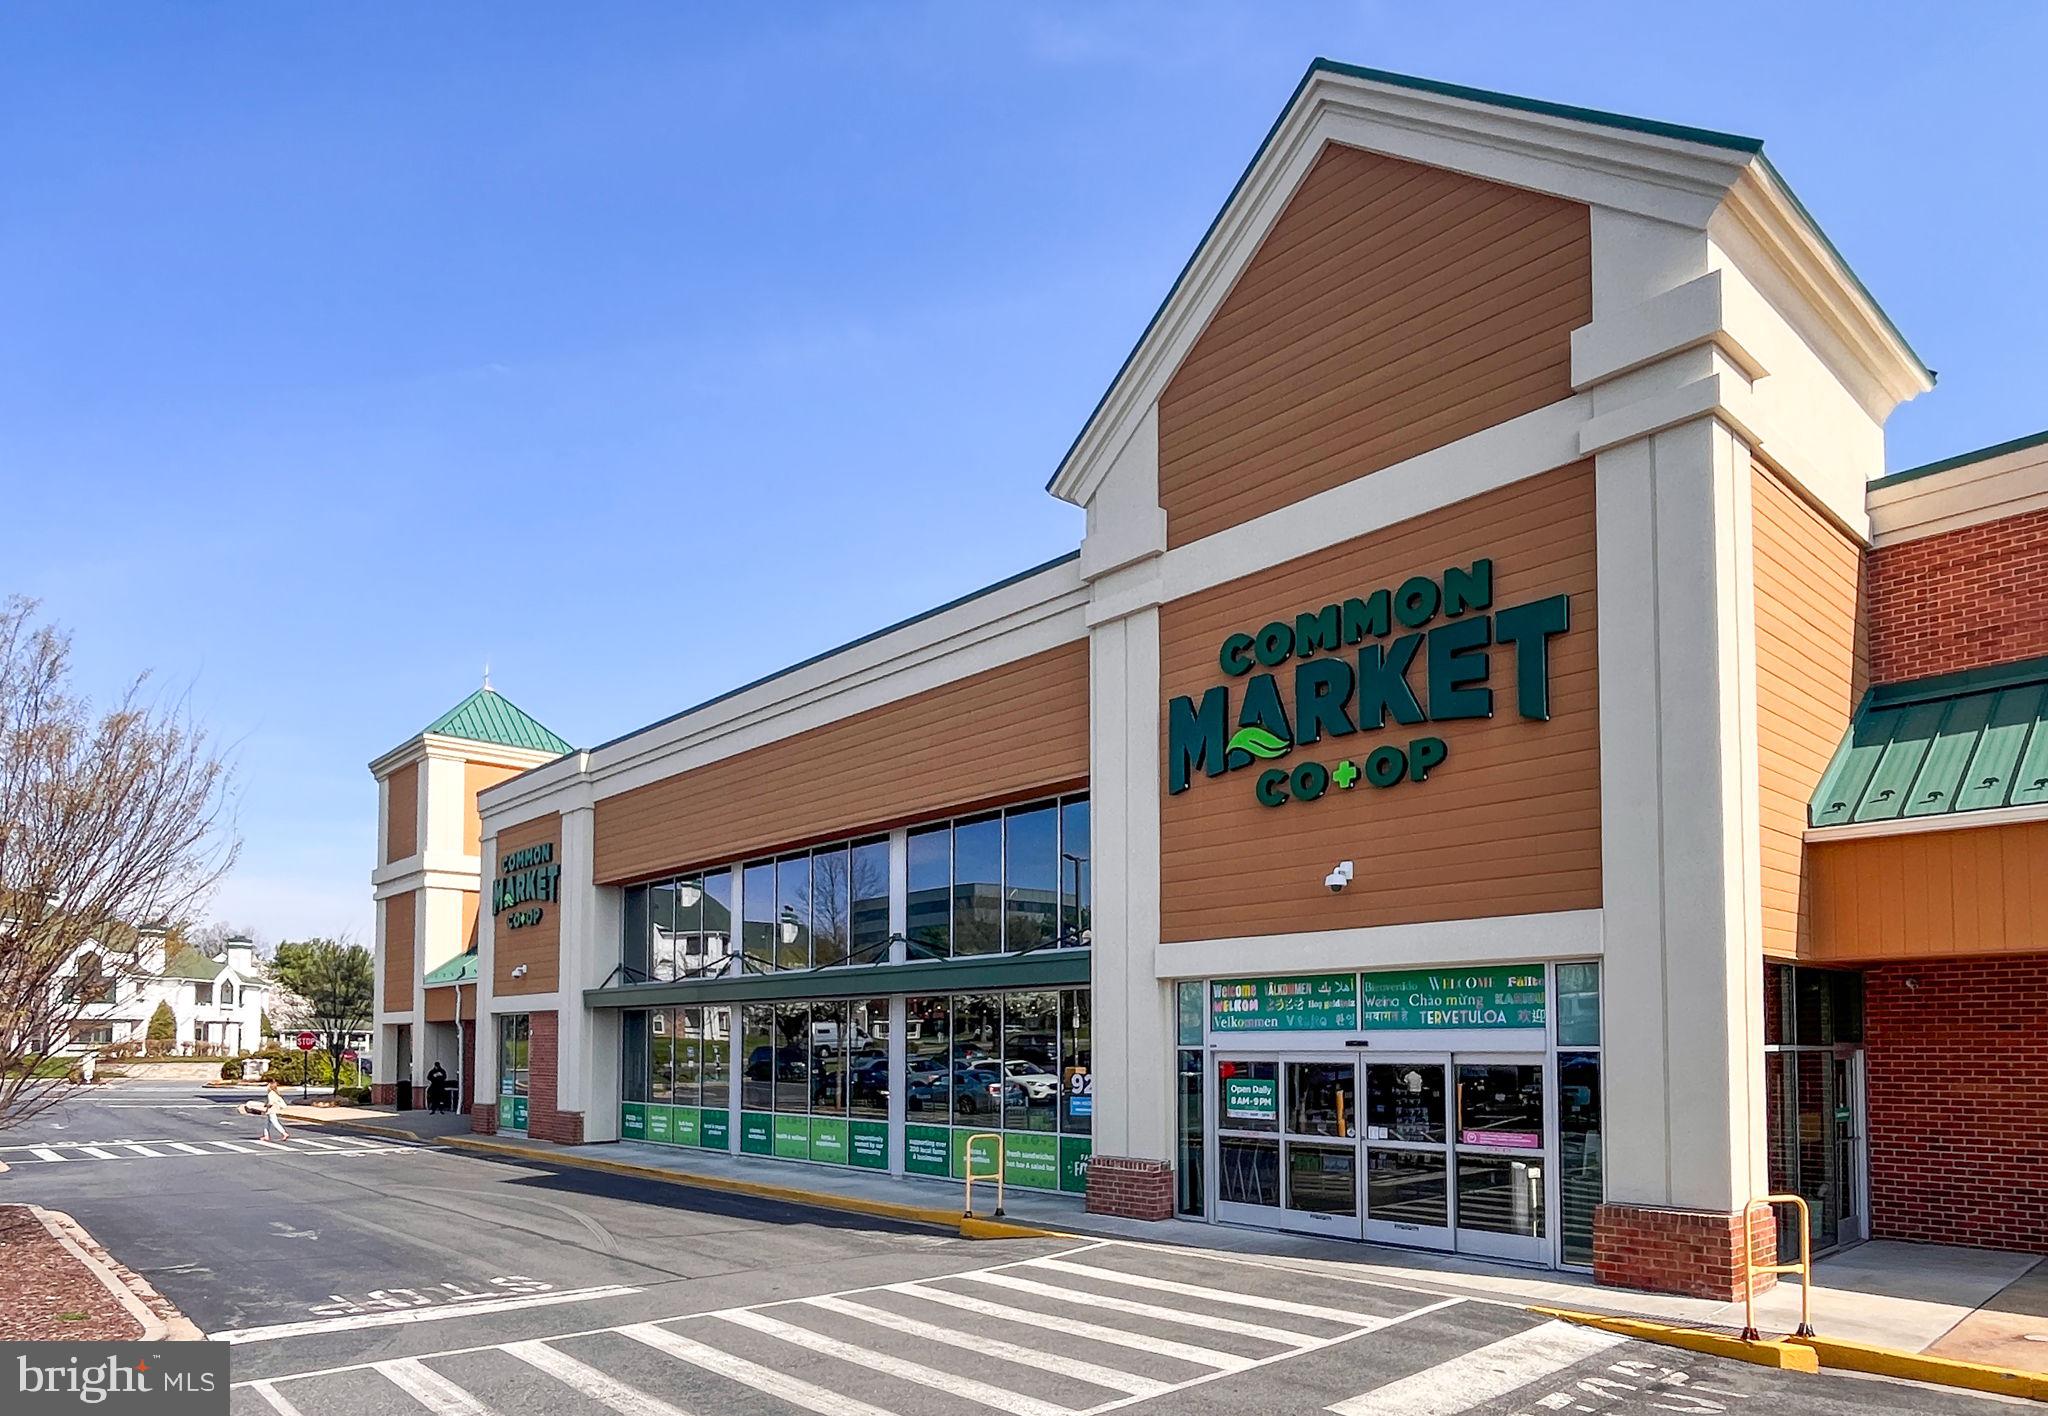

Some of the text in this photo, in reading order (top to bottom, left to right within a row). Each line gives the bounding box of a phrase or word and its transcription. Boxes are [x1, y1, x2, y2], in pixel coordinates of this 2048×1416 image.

[1220, 558, 1494, 676] COMMON
[1168, 593, 1570, 795] MARKET
[502, 843, 553, 873] COMMON
[493, 864, 561, 916] MARKET
[1212, 984, 1257, 998] Welcome
[1213, 999, 1259, 1013] WELKOM
[1408, 993, 1442, 1007] Chào
[1214, 1015, 1279, 1028] Velkommen
[1419, 1009, 1507, 1025] TERVETULOA
[297, 1037, 315, 1046] STOP
[1231, 1085, 1272, 1095] Open Daily
[1006, 1149, 1056, 1161] fresh sandwiches
